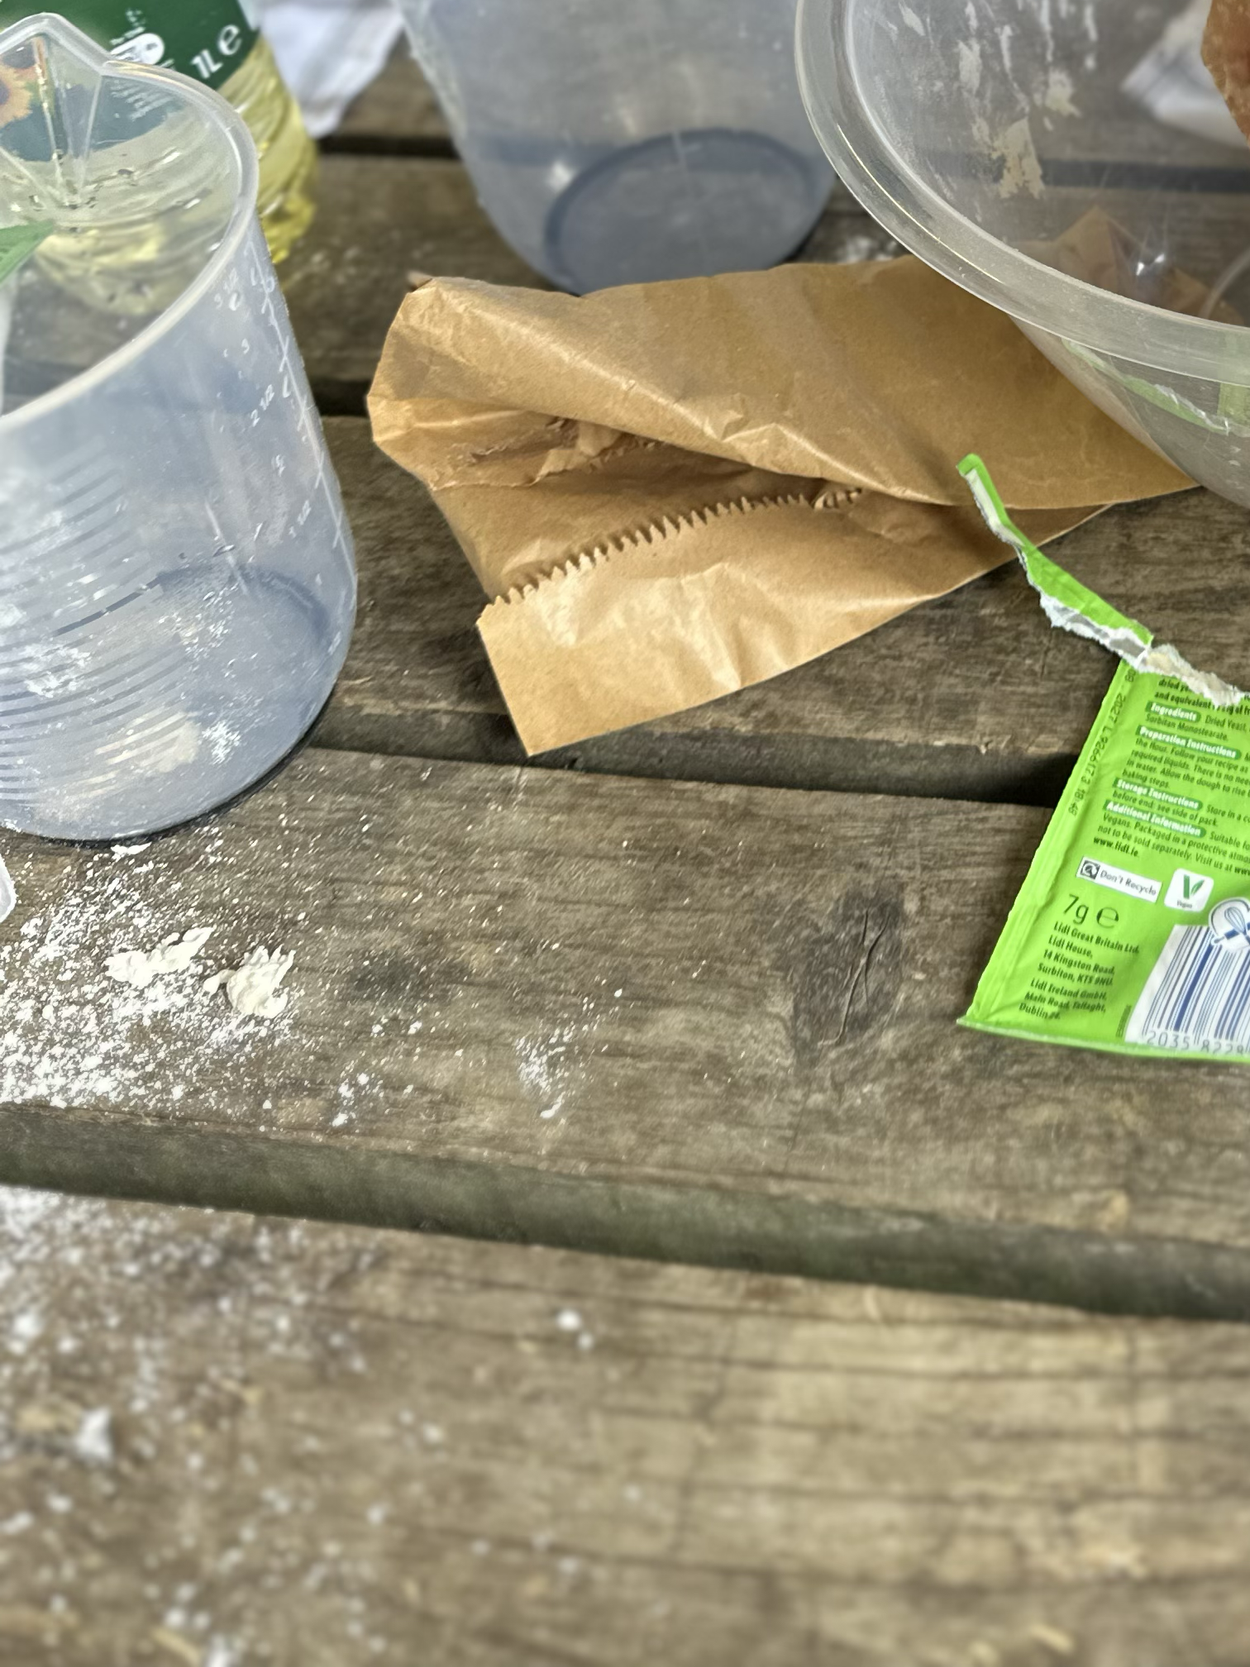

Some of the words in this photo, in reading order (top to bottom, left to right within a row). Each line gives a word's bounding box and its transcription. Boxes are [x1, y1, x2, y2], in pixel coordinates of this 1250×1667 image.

[190, 49, 223, 79] 1L
[1109, 693, 1126, 723] 2027
[1154, 692, 1170, 700] and
[1170, 695, 1211, 708] equivalent
[1235, 705, 1243, 714] of
[1146, 715, 1176, 728] Sorbitan
[1151, 702, 1197, 721] Ingredients
[1205, 715, 1226, 727] Dried
[1136, 738, 1148, 747] the
[1171, 748, 1195, 759] Follow
[1197, 756, 1214, 764] your
[1215, 760, 1238, 770] recipe
[1140, 726, 1186, 745] Preparation
[1187, 739, 1236, 758] Instructions
[1122, 769, 1148, 783] baking
[1131, 750, 1163, 764] required
[1164, 756, 1191, 770] liquids.
[1194, 765, 1214, 777] There
[1126, 758, 1134, 766] in
[1161, 767, 1181, 779] Allow
[1183, 774, 1194, 782] the
[1197, 778, 1220, 790] dough
[1232, 787, 1246, 796] rise
[1113, 790, 1137, 804] before
[1157, 804, 1170, 813] see
[1172, 807, 1187, 819] side
[1189, 813, 1198, 821] of
[1117, 780, 1148, 795] Storage
[1149, 788, 1198, 809] Instructions
[1207, 804, 1226, 817] Store
[1103, 813, 1132, 828] Vegans.
[1134, 822, 1171, 841] Packaged
[1188, 840, 1227, 857] protective
[1106, 801, 1150, 821] Additional
[1151, 814, 1201, 836] Information
[1209, 831, 1240, 847] Suitable
[1098, 826, 1111, 834] not
[1122, 831, 1132, 840] be
[1134, 836, 1151, 847] sold
[1151, 843, 1193, 860] separately.
[1195, 852, 1212, 865] Visit
[1214, 859, 1223, 869] us
[1100, 870, 1124, 884] Don't
[1125, 877, 1156, 896] Recycle
[1063, 894, 1089, 925] 7g
[1048, 935, 1065, 949] Lidl
[1066, 942, 1093, 958] House,
[1054, 921, 1071, 934] Lidl
[1071, 928, 1094, 943] Great
[1095, 936, 1123, 951] Britain
[1124, 944, 1139, 954] Ltd.
[1043, 949, 1052, 959] 14
[1053, 951, 1092, 971] Kingston
[1038, 963, 1075, 982] Surbiton,
[1077, 973, 1093, 985] KT5
[1024, 992, 1046, 1004] Main
[1031, 978, 1047, 992] Lidl
[1048, 984, 1079, 999] Ireland
[1019, 1002, 1049, 1019] Dublin
[1146, 1031, 1190, 1050] 2035
